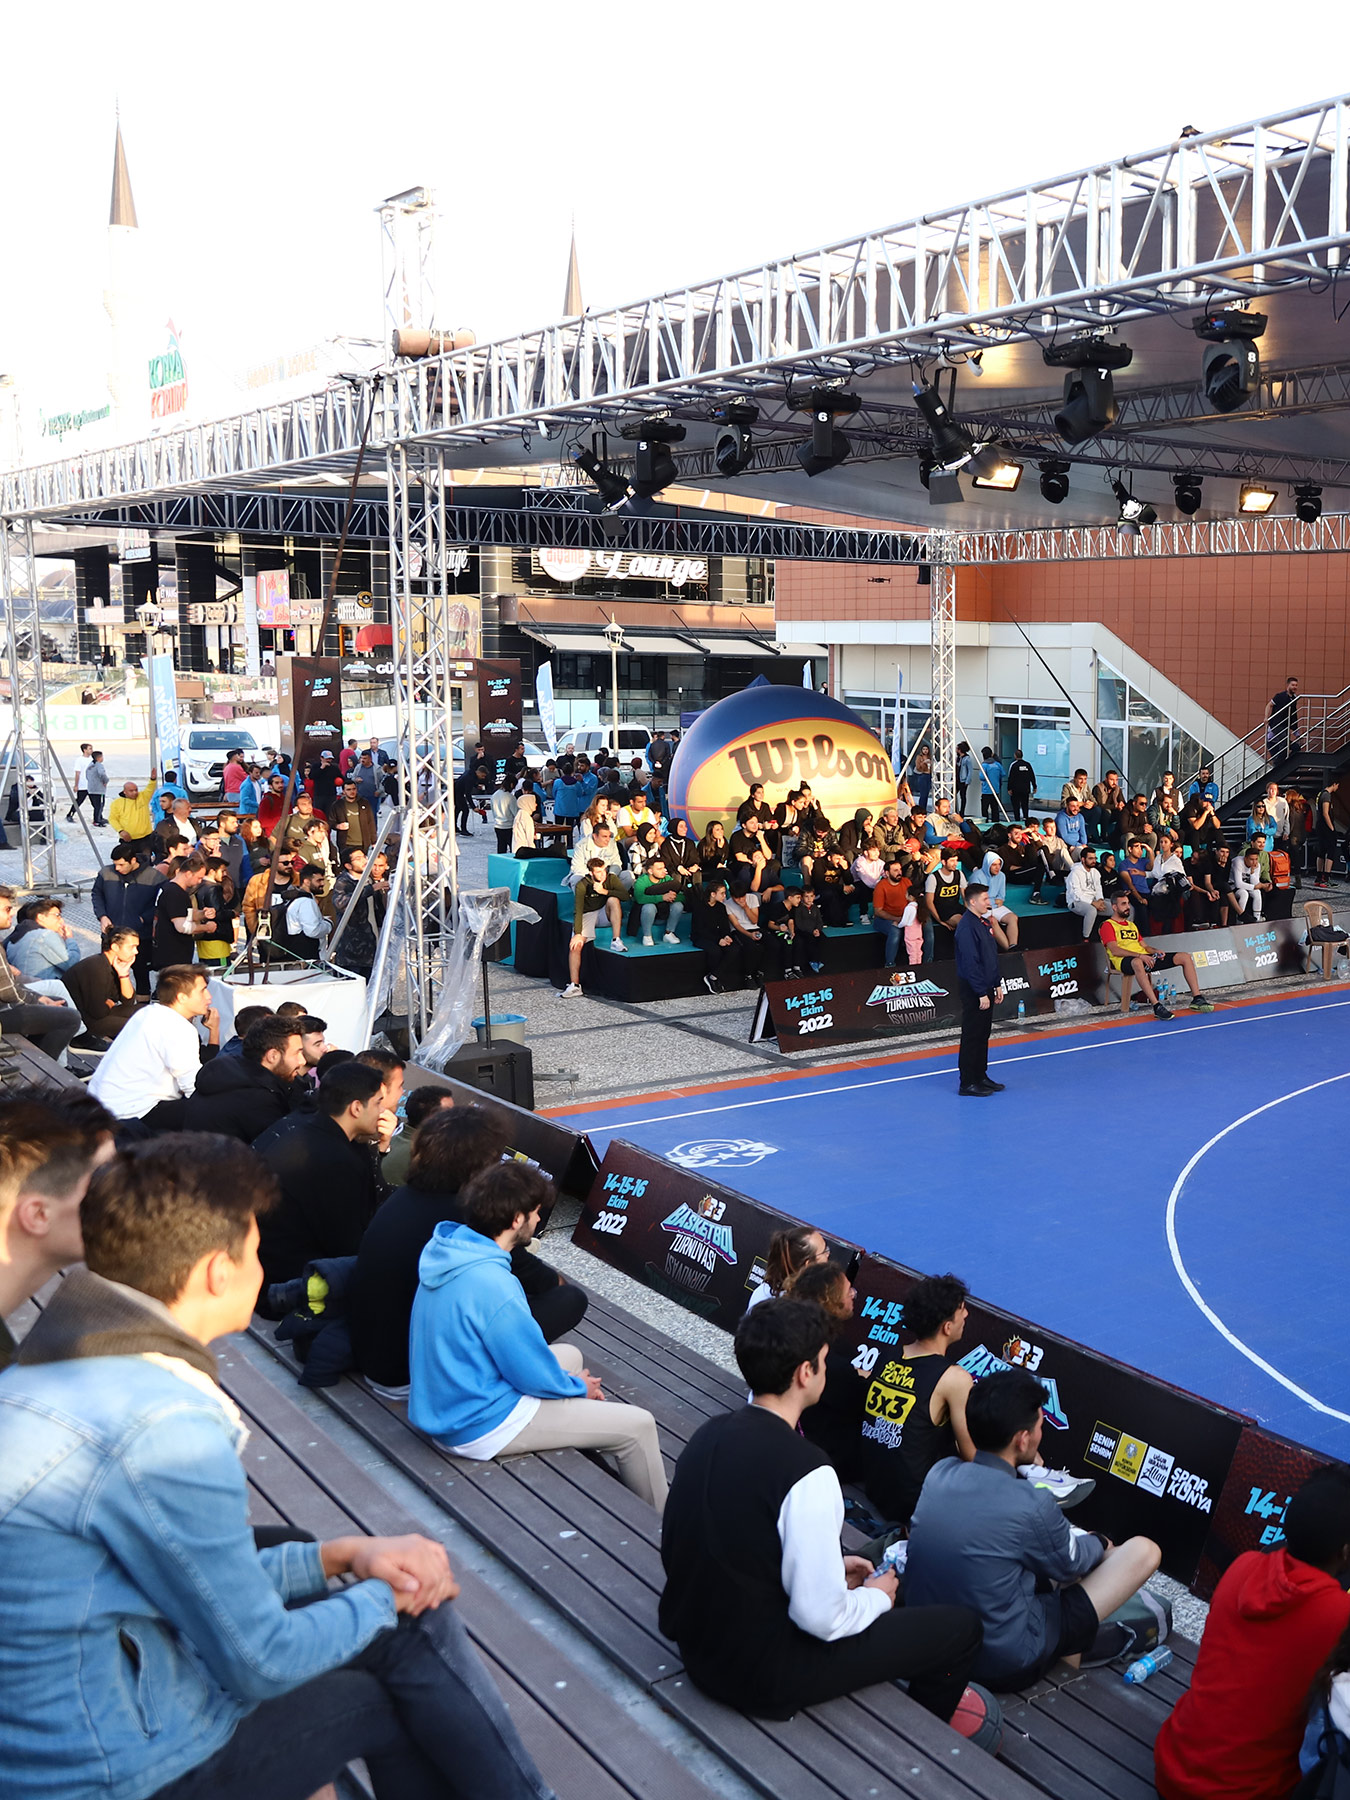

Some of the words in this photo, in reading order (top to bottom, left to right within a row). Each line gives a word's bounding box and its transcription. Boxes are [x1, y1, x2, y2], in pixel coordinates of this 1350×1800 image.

[1247, 351, 1257, 363] 8
[1098, 368, 1108, 380] 7
[818, 412, 828, 422] 6
[639, 441, 648, 451] 5
[742, 434, 750, 442] 7
[596, 550, 707, 587] Lounge
[337, 603, 355, 620] COFFEE
[729, 734, 892, 787] Wilson
[1244, 931, 1277, 948] 14-15-16
[1037, 956, 1078, 976] 14-15-16
[1254, 951, 1279, 968] 2022
[1051, 971, 1070, 983] Ekim
[867, 979, 949, 1004] BASKETBOL
[1049, 979, 1079, 998] 2022
[785, 988, 834, 1011] 14-15-16
[885, 996, 936, 1013] TURNUVASI
[800, 1004, 824, 1017] Ekim
[798, 1013, 834, 1035] 2022
[602, 1172, 649, 1198] 14-15-16
[606, 1195, 629, 1210] Ekim
[592, 1210, 628, 1236] 2022
[661, 1203, 738, 1264] BASKETBOL
[669, 1233, 717, 1273] TURNUVASI
[868, 1324, 900, 1346] Ekim
[867, 1384, 909, 1420] 3x3
[1170, 1467, 1209, 1495] SPOR
[1167, 1480, 1213, 1514] KONYA
